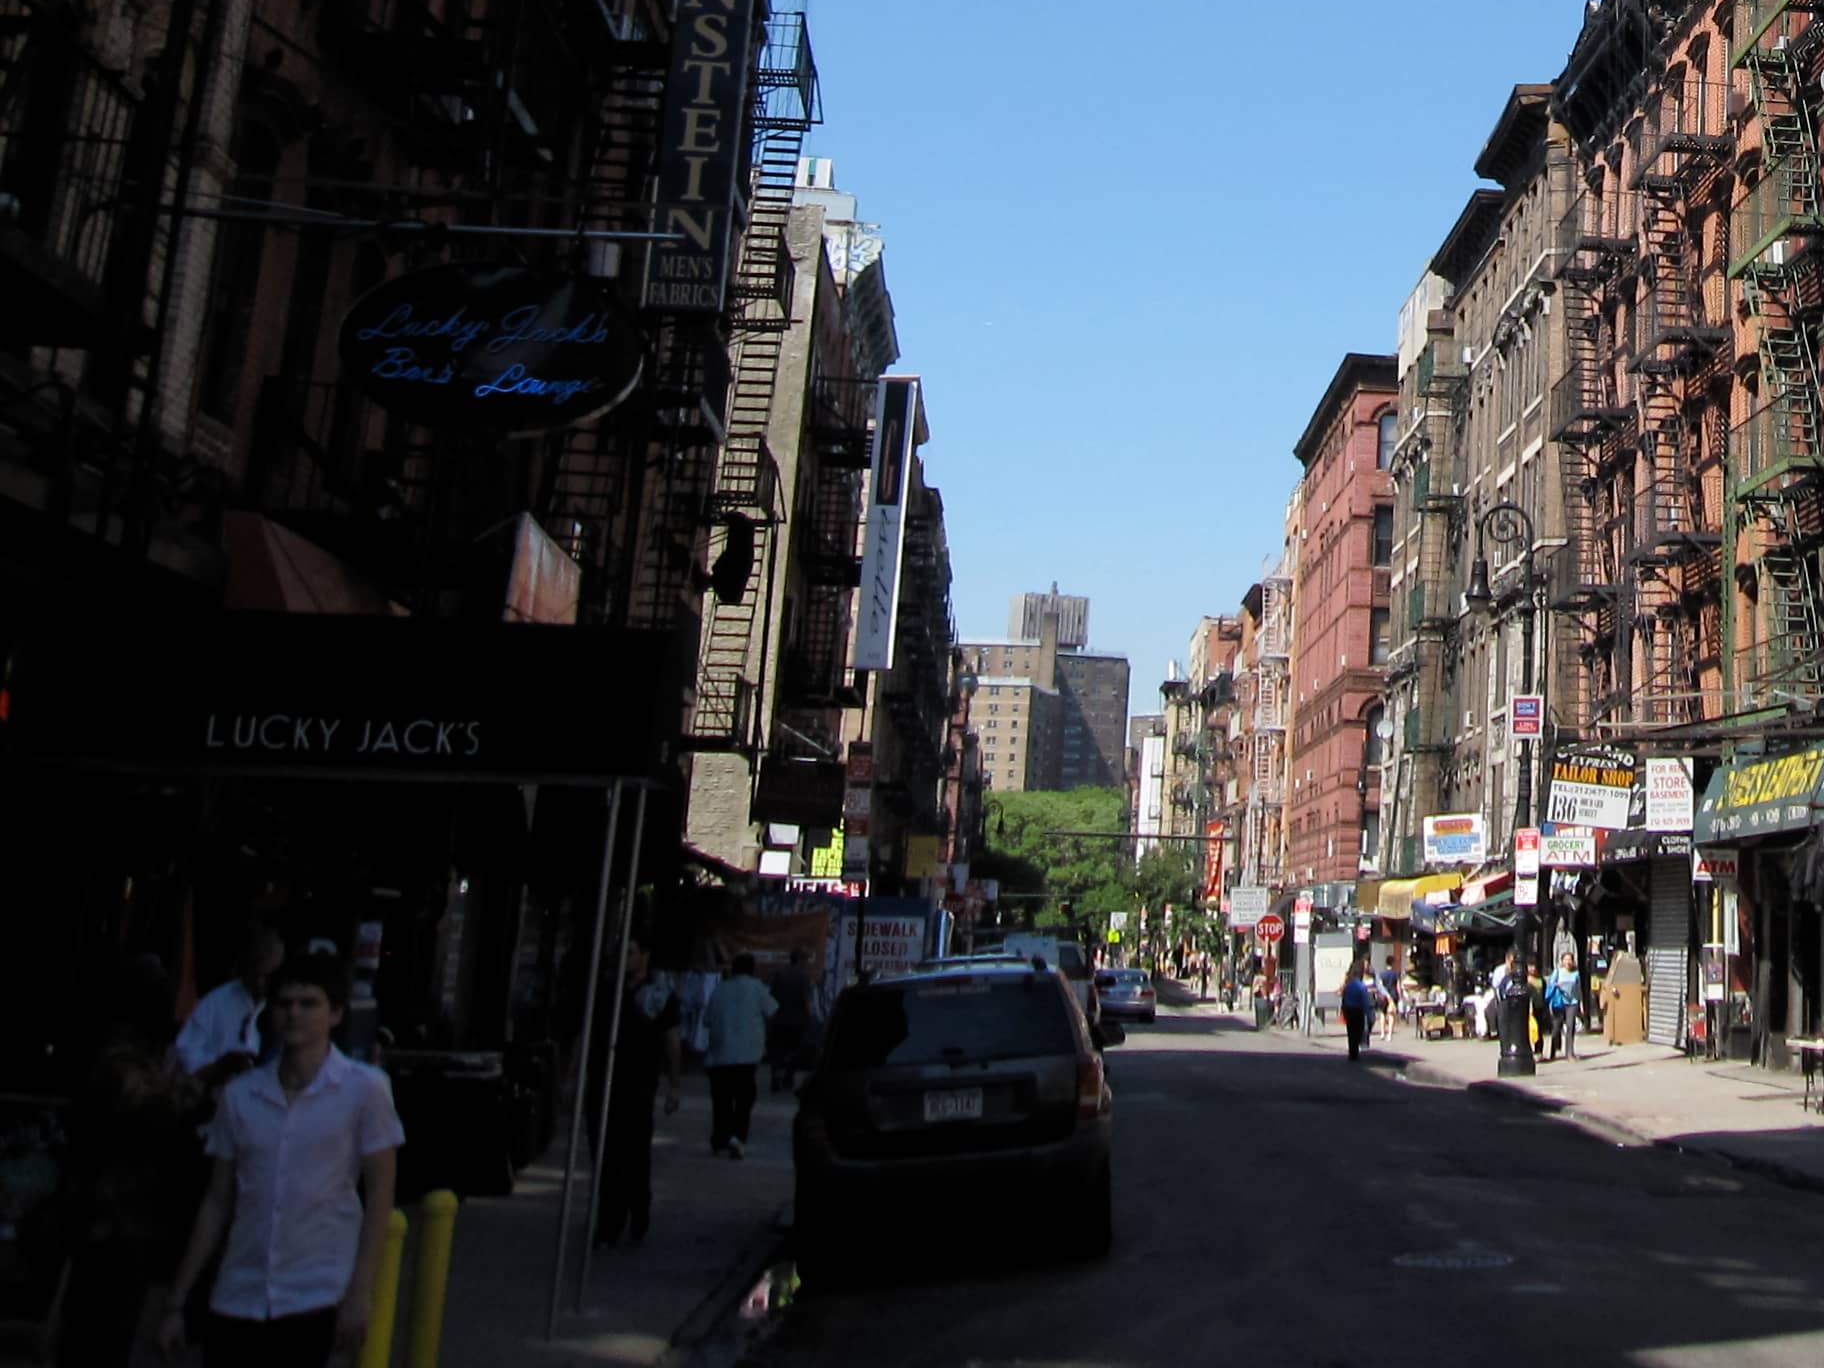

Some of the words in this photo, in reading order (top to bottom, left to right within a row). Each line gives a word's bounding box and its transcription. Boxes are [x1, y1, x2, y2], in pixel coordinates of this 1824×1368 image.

[657, 253, 715, 281] MEN'S
[648, 282, 720, 308] FABRICS
[205, 712, 341, 751] LUCKY
[355, 717, 482, 758] JACK'S
[1553, 762, 1598, 784] TAILOR
[1601, 769, 1634, 788] SHOP
[1651, 764, 1668, 773] FOR
[1653, 776, 1687, 790] STORE
[1649, 790, 1689, 800] BASEMENT
[1547, 840, 1585, 850] GROCERY
[1546, 850, 1590, 862] ATM
[1697, 859, 1737, 873] ATM
[847, 921, 918, 937] SDEWALK
[1258, 923, 1283, 935] STOP
